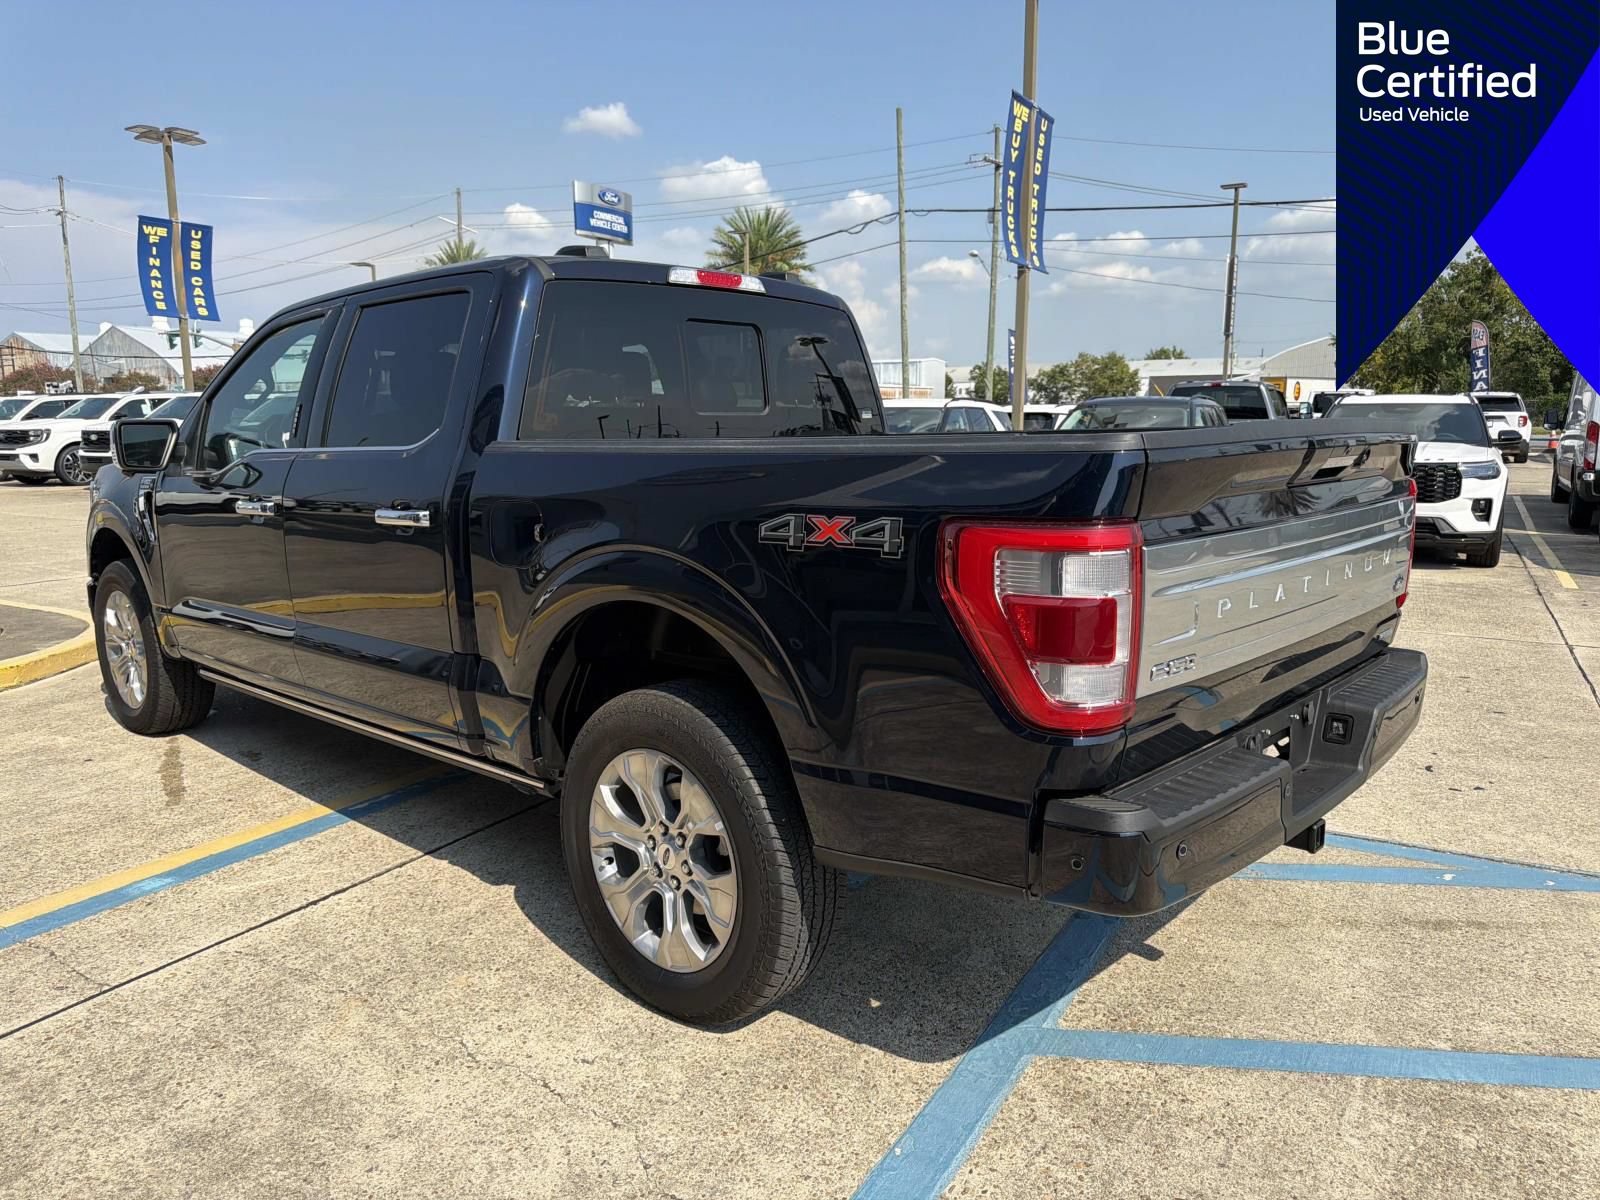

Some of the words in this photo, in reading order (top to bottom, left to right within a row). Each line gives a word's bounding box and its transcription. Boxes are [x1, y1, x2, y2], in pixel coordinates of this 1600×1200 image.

[1013, 100, 1030, 123] WE
[1010, 118, 1023, 163] BUY
[1034, 118, 1048, 176] USED
[142, 225, 168, 237] WE
[589, 217, 612, 230] VEHICLE
[611, 221, 628, 233] CENTER
[593, 210, 625, 225] COMMERCIAL
[1006, 170, 1019, 259] TRUCKS
[1030, 183, 1041, 268] TRUCKS
[190, 229, 203, 271] USED
[148, 235, 168, 310] FINANCE
[191, 276, 209, 317] CARS
[1217, 548, 1392, 618] PLATINUM
